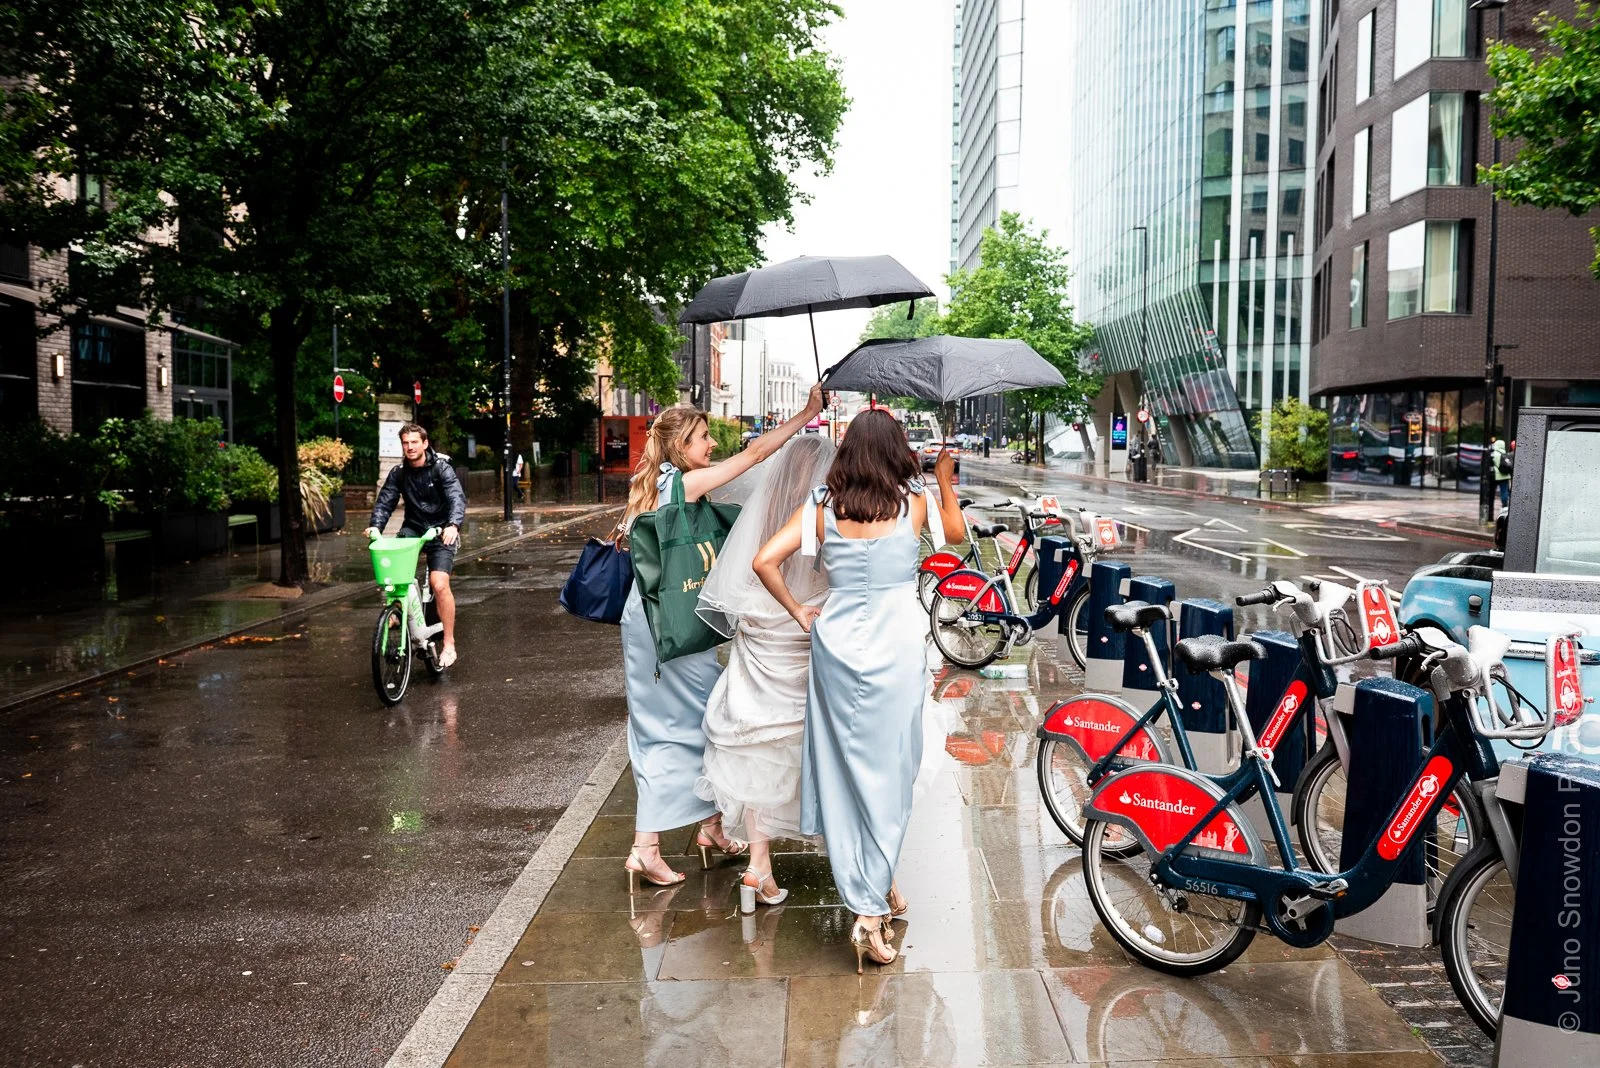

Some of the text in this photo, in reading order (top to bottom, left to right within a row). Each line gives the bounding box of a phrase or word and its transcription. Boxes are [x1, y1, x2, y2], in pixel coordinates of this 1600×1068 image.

[951, 582, 977, 592] Santander
[1074, 716, 1121, 733] Santander
[1266, 712, 1286, 740] Santander
[1132, 792, 1196, 816] Santander
[1397, 797, 1423, 831] Santander
[1185, 879, 1218, 895] 56516
